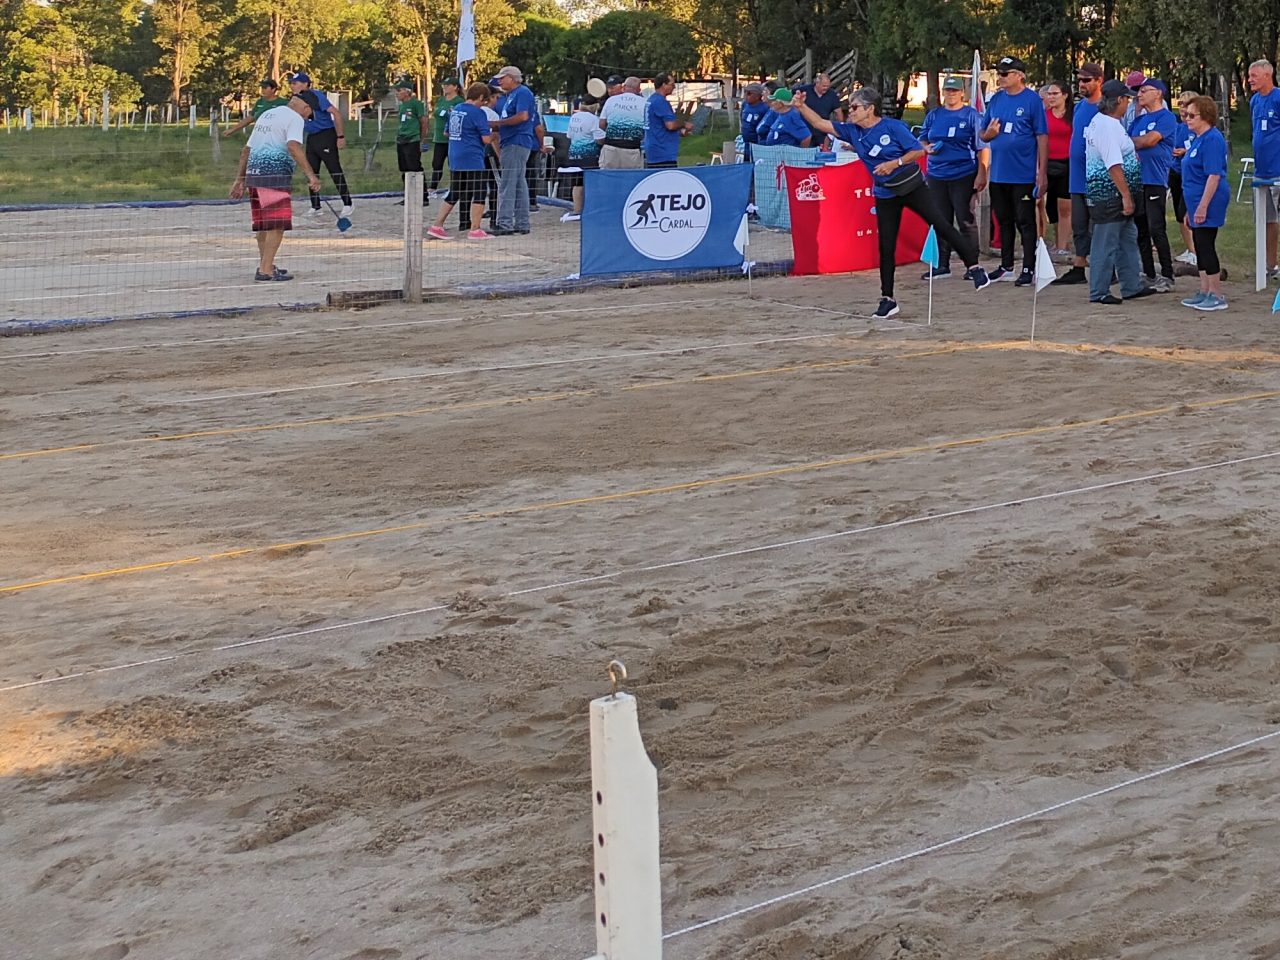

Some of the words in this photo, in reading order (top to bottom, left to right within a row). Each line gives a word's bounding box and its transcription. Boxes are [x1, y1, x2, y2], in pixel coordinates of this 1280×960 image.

[854, 188, 873, 198] TE
[656, 193, 706, 211] TEJO
[659, 217, 694, 233] CARDAL
